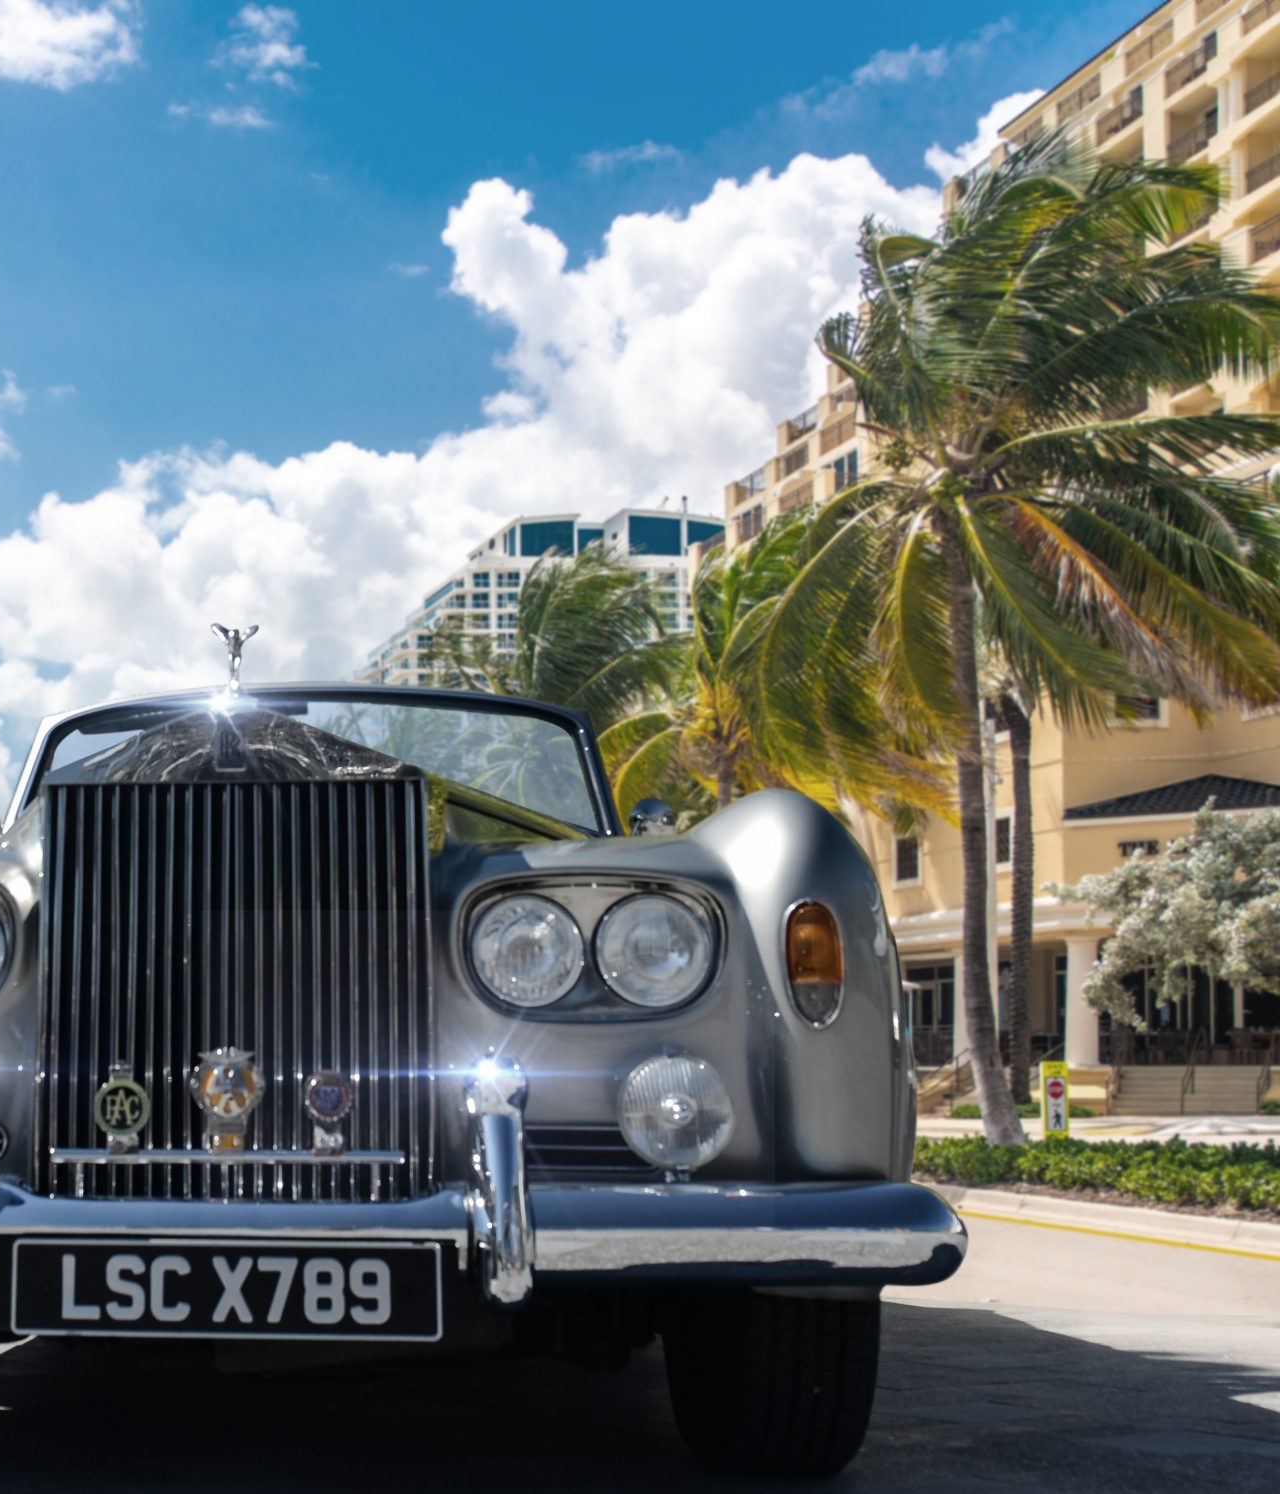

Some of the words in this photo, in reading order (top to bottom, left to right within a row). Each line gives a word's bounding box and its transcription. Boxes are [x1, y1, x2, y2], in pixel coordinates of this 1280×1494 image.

[1118, 840, 1159, 857] THE
[106, 1088, 140, 1126] RAC
[61, 1253, 191, 1321] LSC
[212, 1255, 392, 1325] X789
